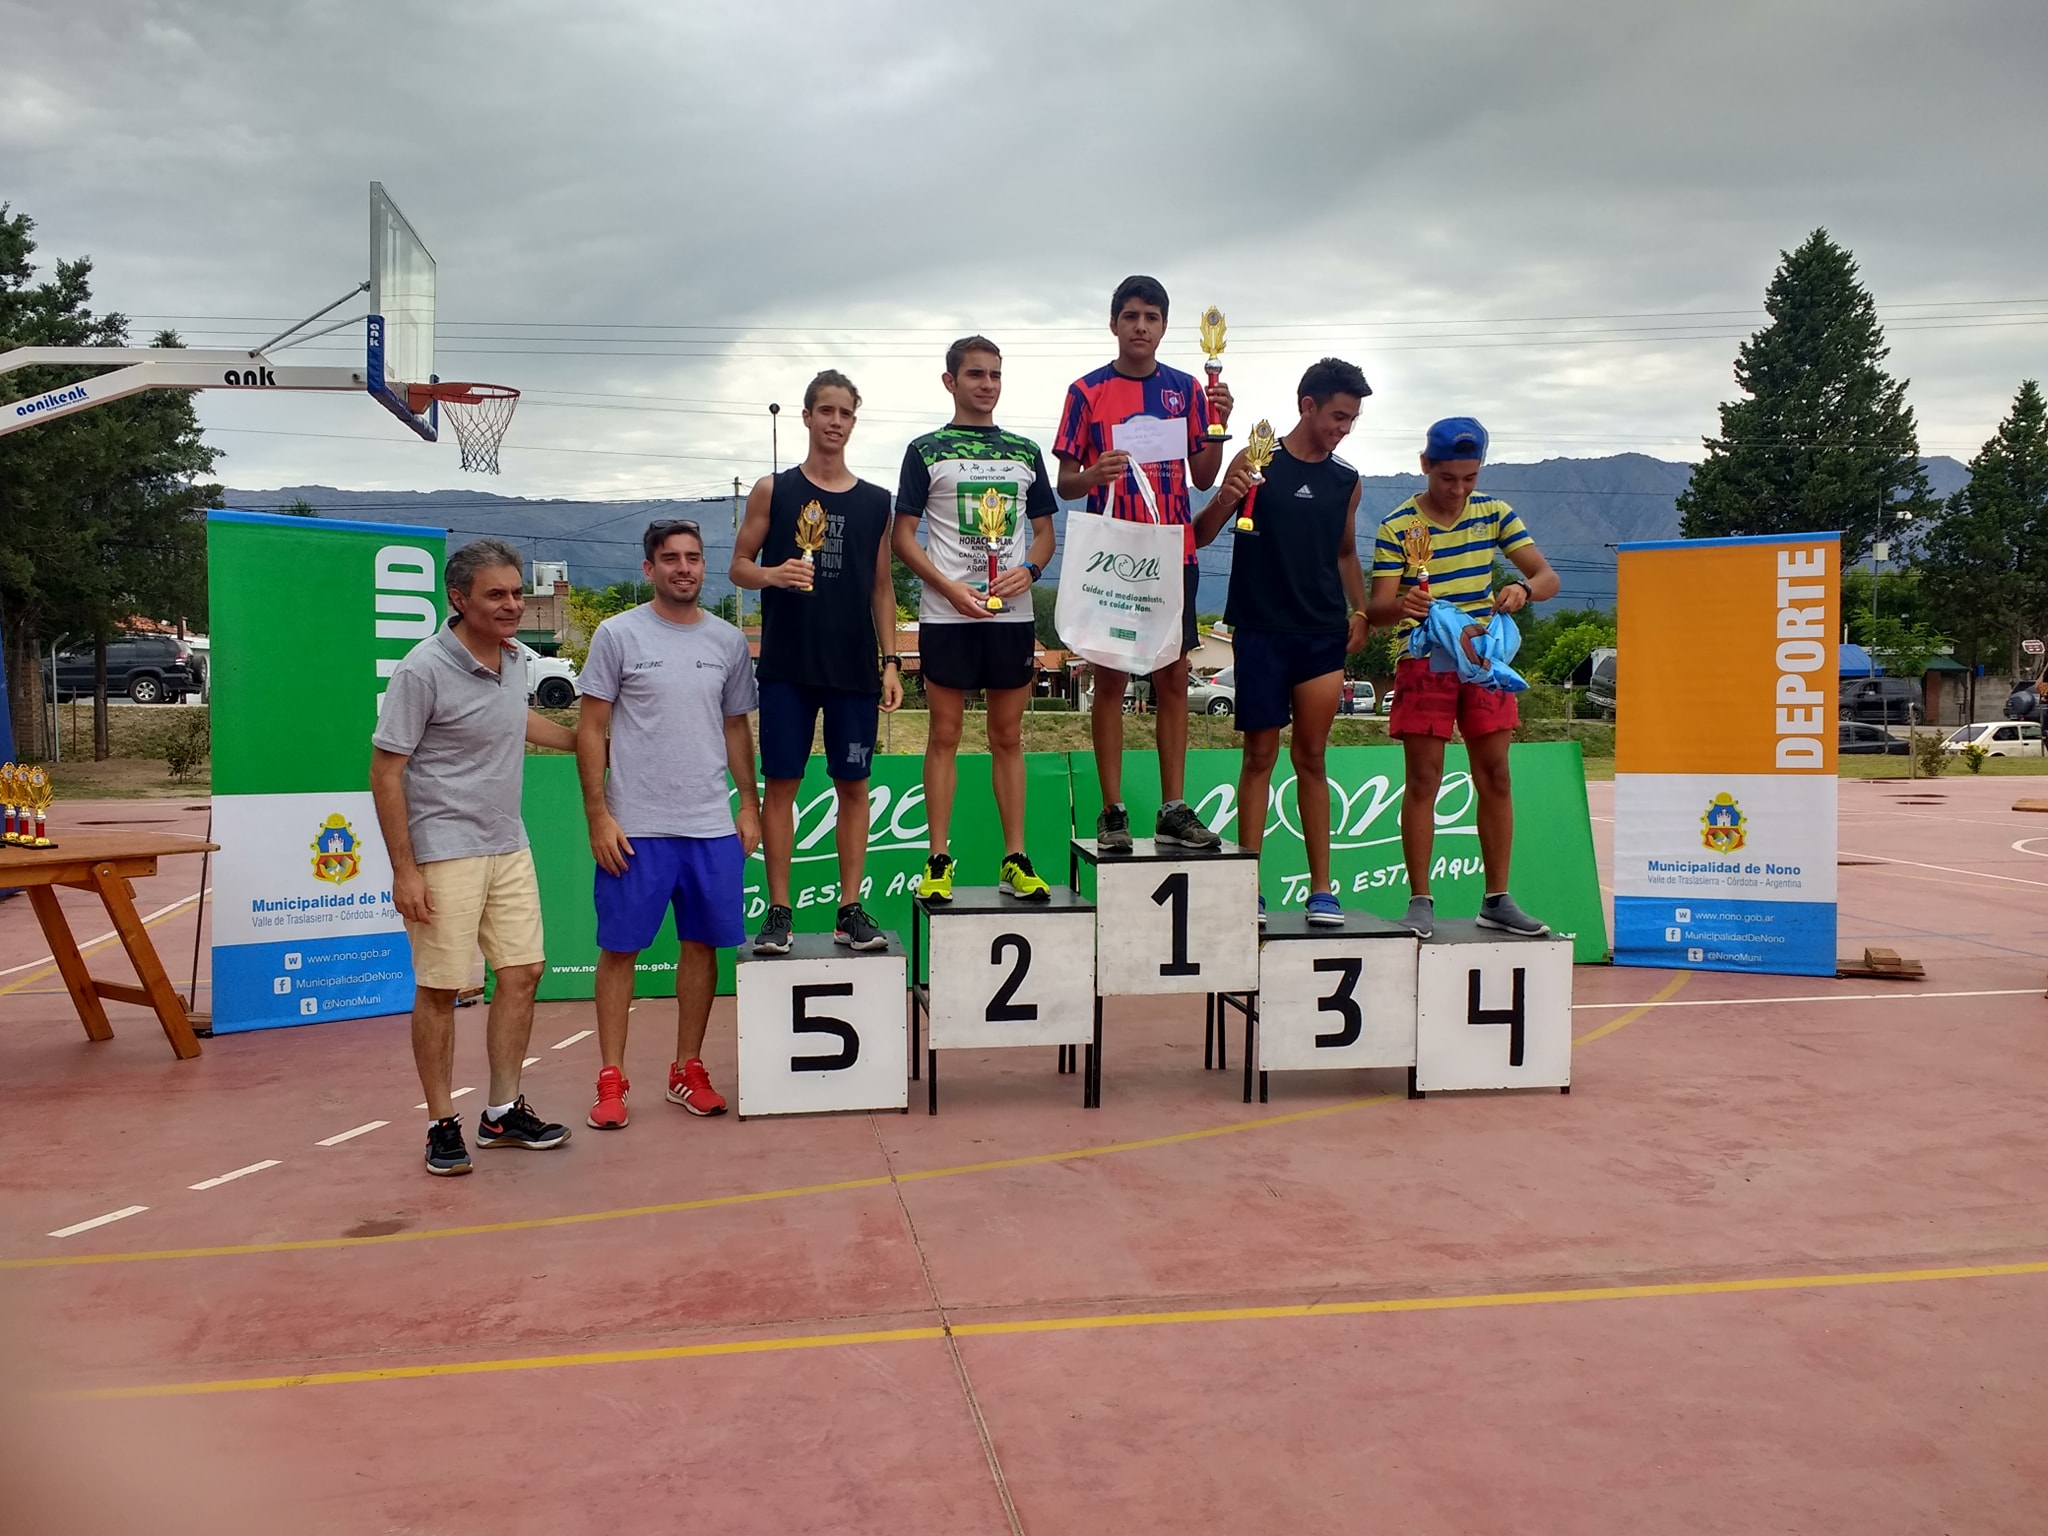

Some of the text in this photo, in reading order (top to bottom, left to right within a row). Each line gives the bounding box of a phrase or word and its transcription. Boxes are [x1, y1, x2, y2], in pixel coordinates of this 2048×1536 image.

[224, 366, 277, 386] ank
[16, 386, 87, 416] aonikenk
[821, 553, 843, 569] RUN
[1082, 583, 1104, 596] Cuidar
[1106, 589, 1113, 598] el
[1110, 600, 1133, 611] cuidar
[1775, 548, 1825, 768] DEPORTE
[1648, 860, 1801, 875] Municipalidad de Nono
[1648, 875, 1665, 884] Valle
[1667, 875, 1676, 884] de
[1678, 875, 1719, 885] Traslasierra
[1727, 876, 1758, 887] Córdoba
[1765, 878, 1802, 889] Argentina
[252, 893, 354, 912] Municipalidad
[359, 892, 376, 905] de
[252, 915, 272, 927] Valle
[274, 914, 284, 925] de
[287, 913, 333, 925] Traslasierra
[340, 908, 374, 920] Córdoba
[1151, 873, 1200, 976] 1
[1695, 912, 1774, 923] www.nono.gob.ar
[1685, 931, 1785, 943] MunicipalidadDeNono
[306, 948, 391, 964] www.nono.gob.ar
[1707, 951, 1762, 962] @NonoMuni
[296, 970, 403, 988] MunicipalidadDeNono
[985, 933, 1038, 1021] 2
[322, 995, 381, 1010] @NonoMuni
[1313, 957, 1363, 1048] 3
[1468, 967, 1525, 1067] 4
[791, 982, 860, 1072] 5
